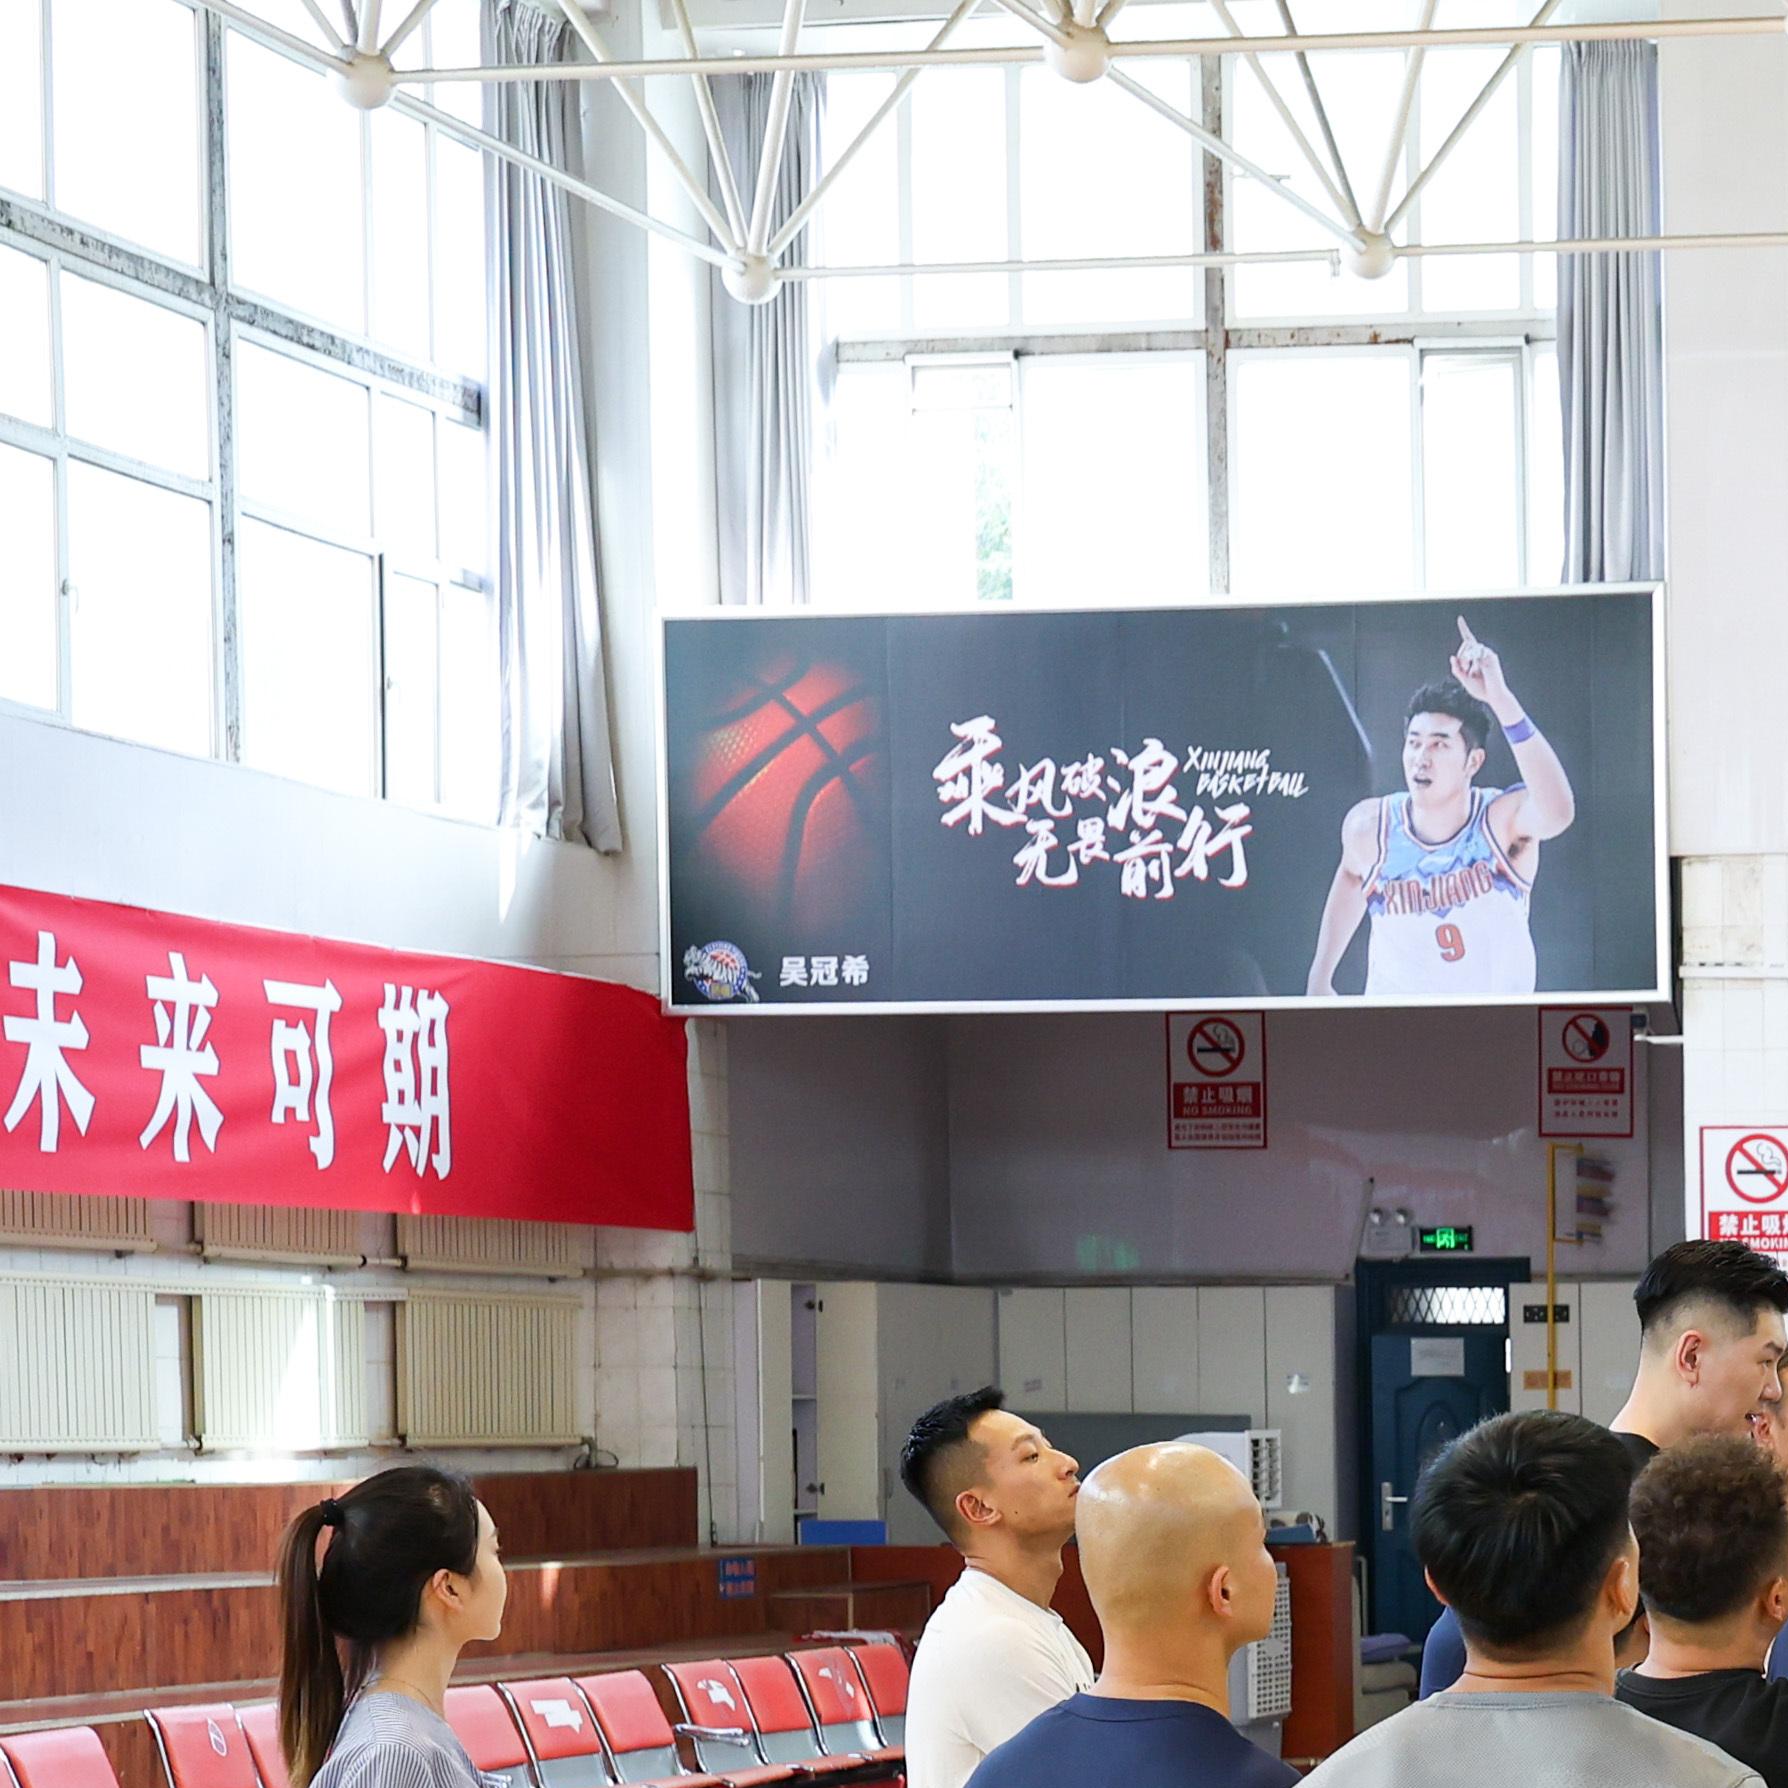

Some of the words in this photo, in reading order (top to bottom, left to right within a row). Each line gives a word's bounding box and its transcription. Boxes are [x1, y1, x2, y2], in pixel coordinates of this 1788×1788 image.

[932, 715, 1187, 836] 乘风破浪
[1183, 745, 1271, 775] XINJIANG
[1196, 771, 1309, 799] BASKETBALL
[1013, 803, 1254, 899] 无畏前行
[1435, 923, 1466, 962] 9
[779, 954, 870, 987] 吴冠希
[3, 930, 452, 1181] 未来可期
